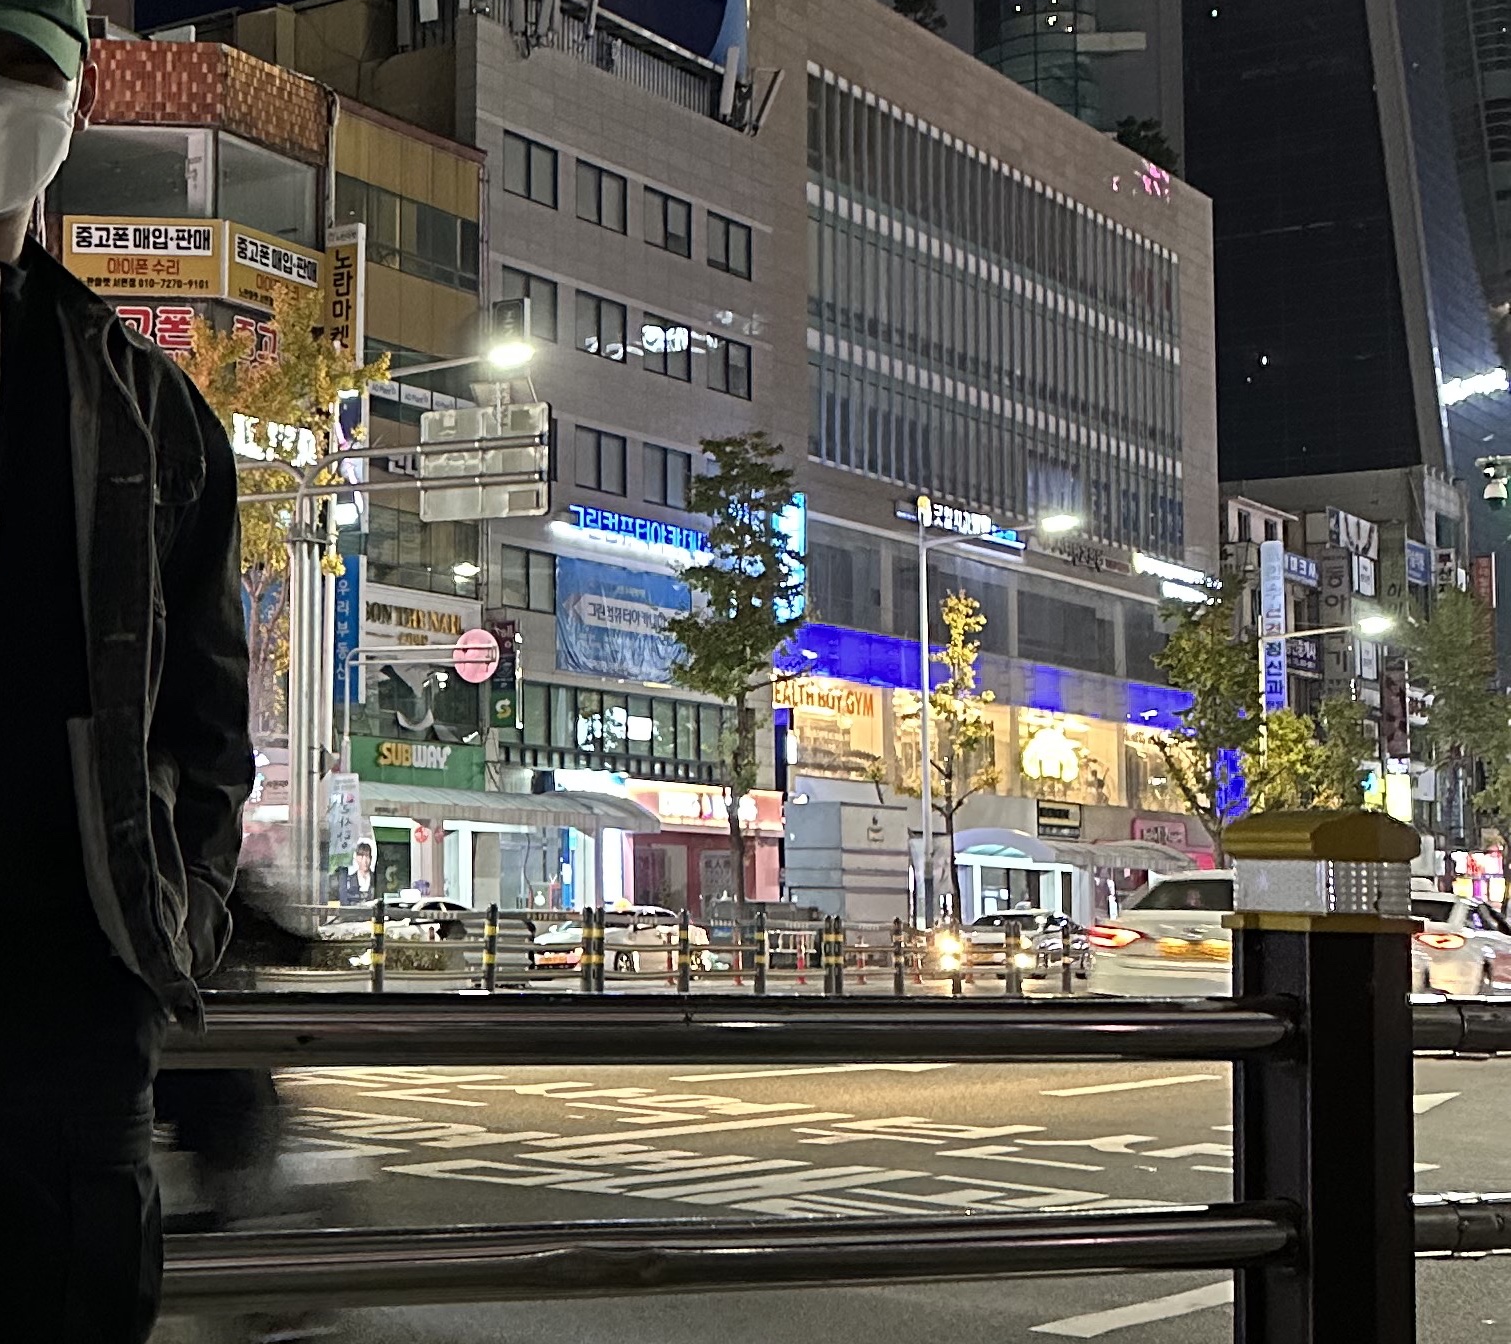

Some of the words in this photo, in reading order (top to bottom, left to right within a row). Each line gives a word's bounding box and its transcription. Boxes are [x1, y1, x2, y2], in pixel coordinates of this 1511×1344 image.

[76, 226, 129, 249] 중고폰
[133, 227, 210, 250] 매입·판매
[237, 236, 270, 268] 중고폰
[107, 258, 148, 275] 아이폰
[152, 259, 179, 275] 수리
[846, 691, 874, 716] GYM
[379, 742, 451, 769] SUBWAY
